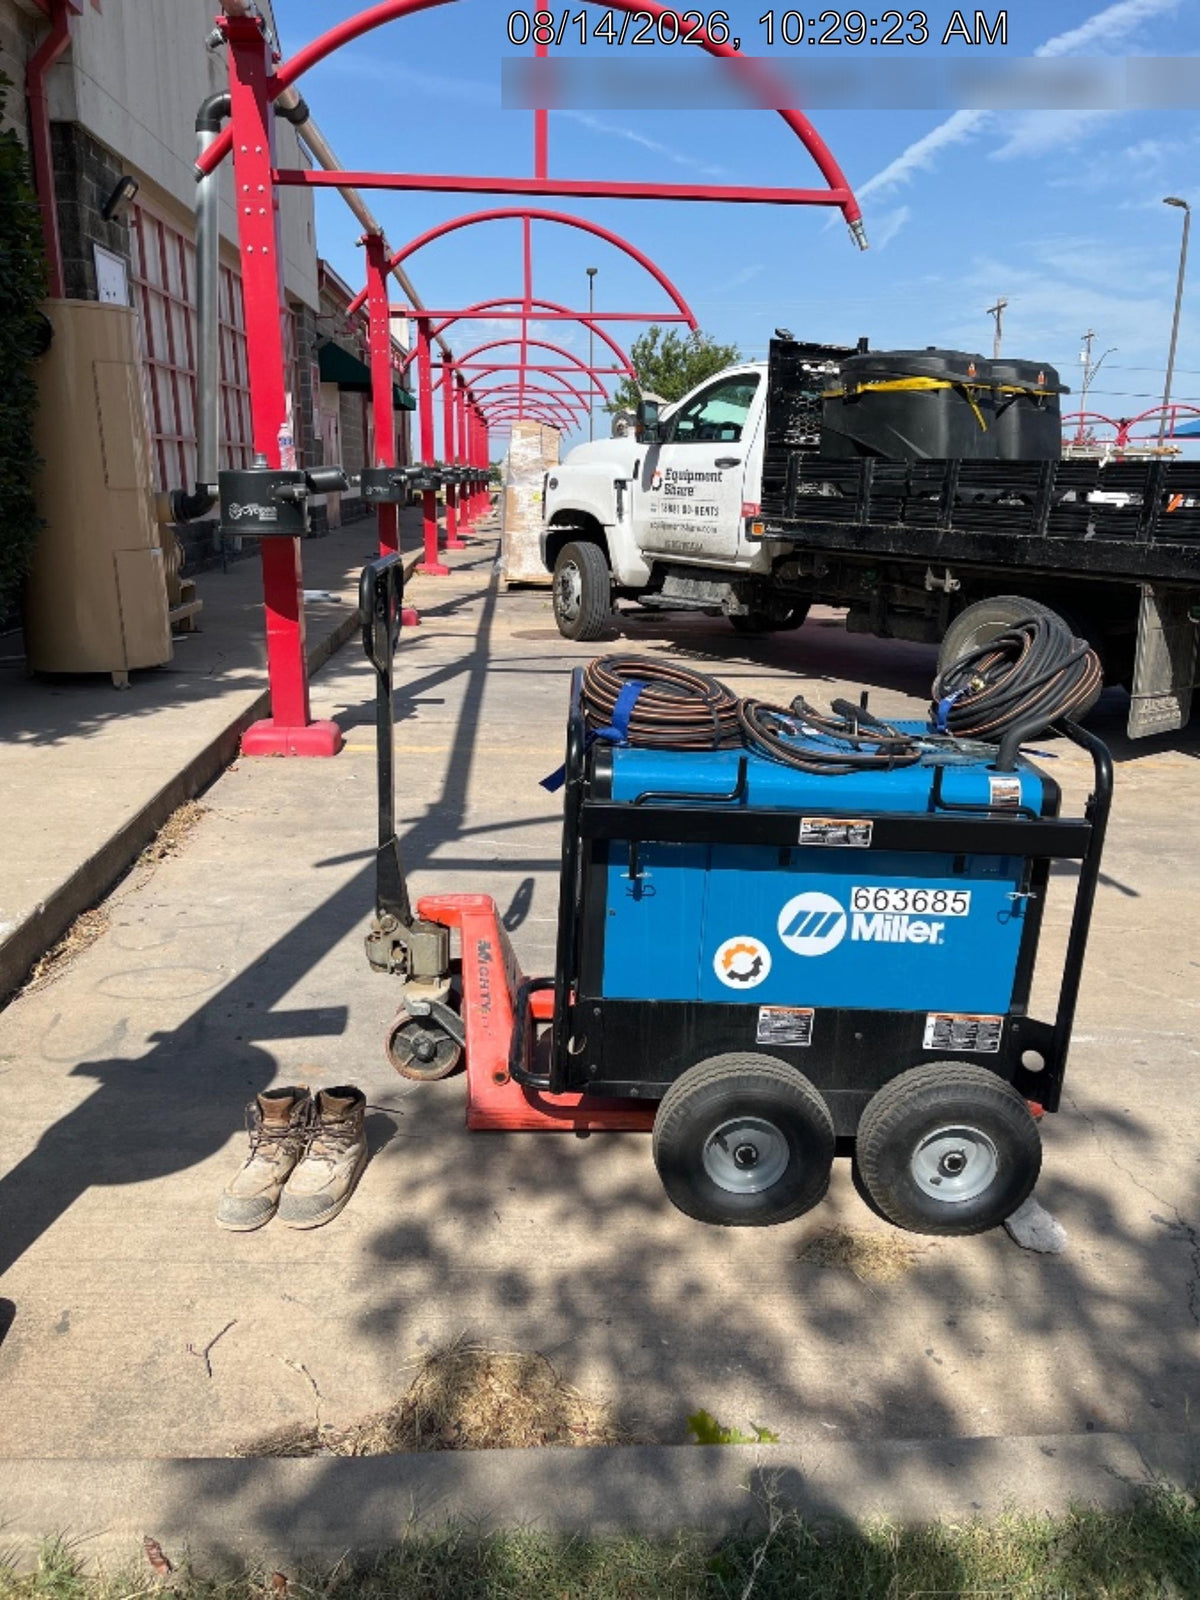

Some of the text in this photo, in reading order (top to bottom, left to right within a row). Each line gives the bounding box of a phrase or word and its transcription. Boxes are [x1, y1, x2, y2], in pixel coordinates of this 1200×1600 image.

[664, 467, 723, 483] Equipment
[664, 483, 695, 497] Share
[853, 887, 968, 914] 663685
[851, 913, 945, 943] Miller
